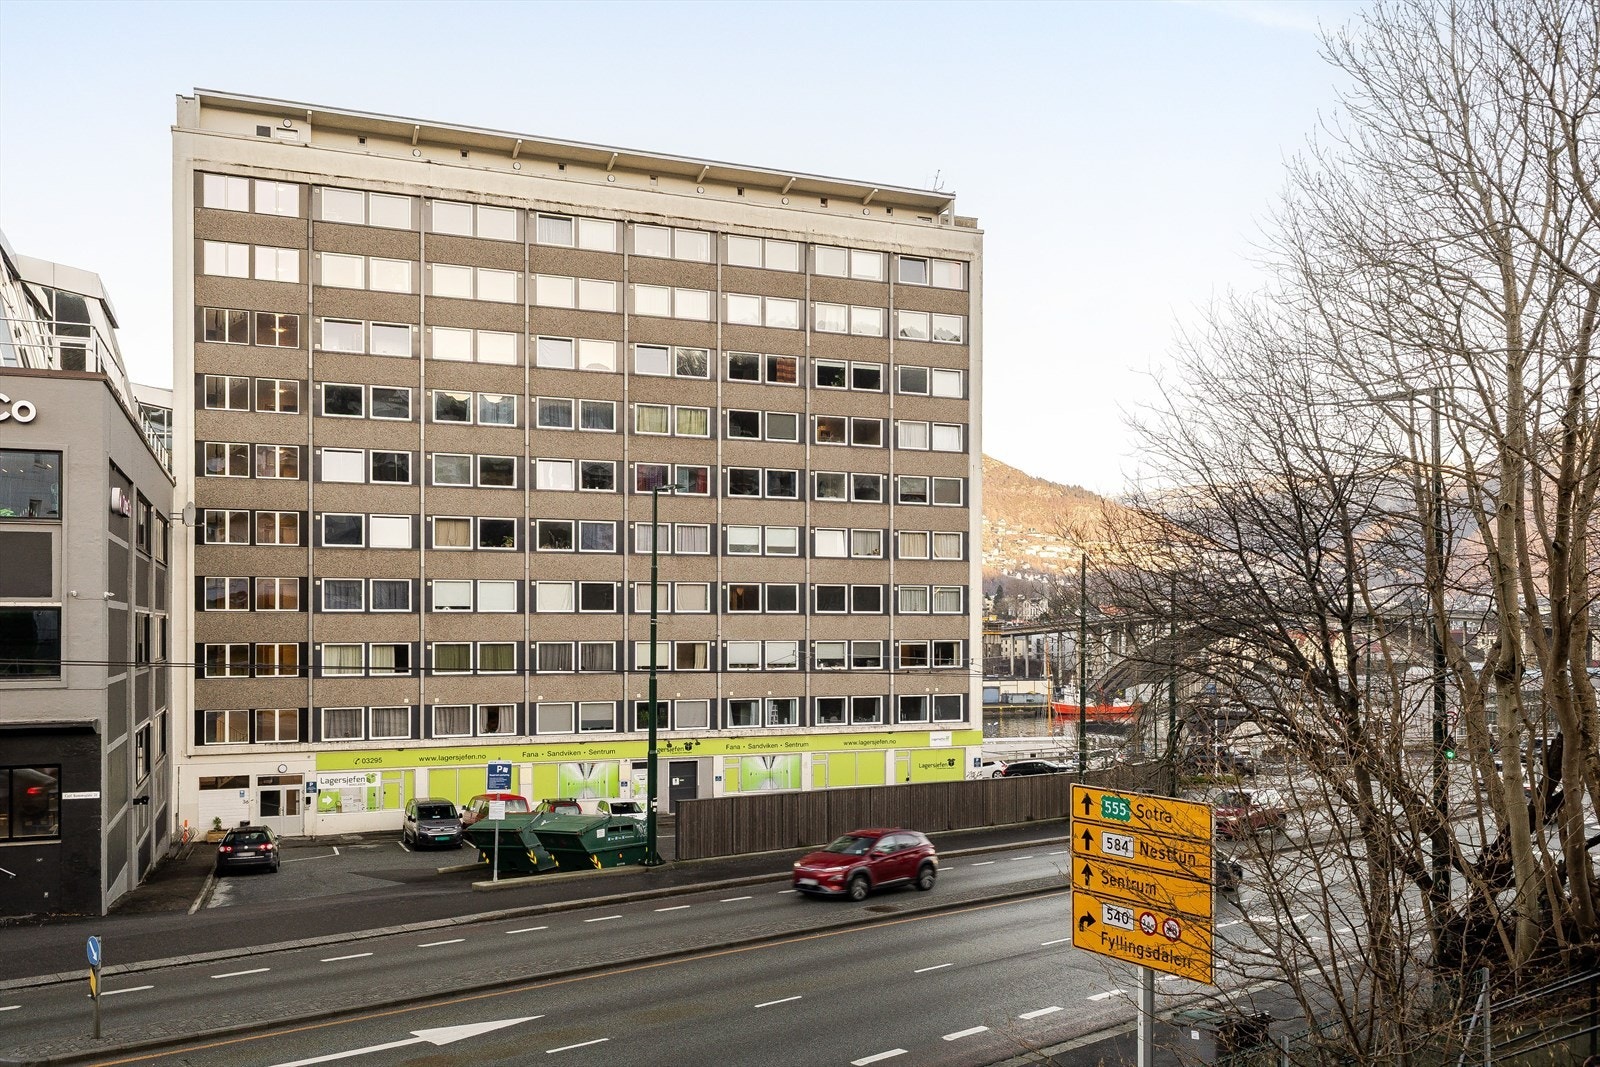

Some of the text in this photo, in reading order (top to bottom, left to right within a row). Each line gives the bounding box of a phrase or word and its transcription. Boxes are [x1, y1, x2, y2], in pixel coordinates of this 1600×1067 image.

[748, 742, 779, 750] Sandviken
[843, 739, 897, 747] www.lagersjefen.no
[588, 748, 616, 756] Sentrum
[418, 754, 487, 763] www.lagersjefen.no
[918, 761, 948, 770] Lagersjefen
[320, 775, 366, 786] Lagersjefen
[1104, 800, 1173, 824] 555 Sotra
[1106, 837, 1196, 866] 584 Nesttun
[1101, 870, 1157, 896] Sentrum
[1106, 908, 1130, 925] 540
[1101, 931, 1192, 969] Fyllingsdalen
